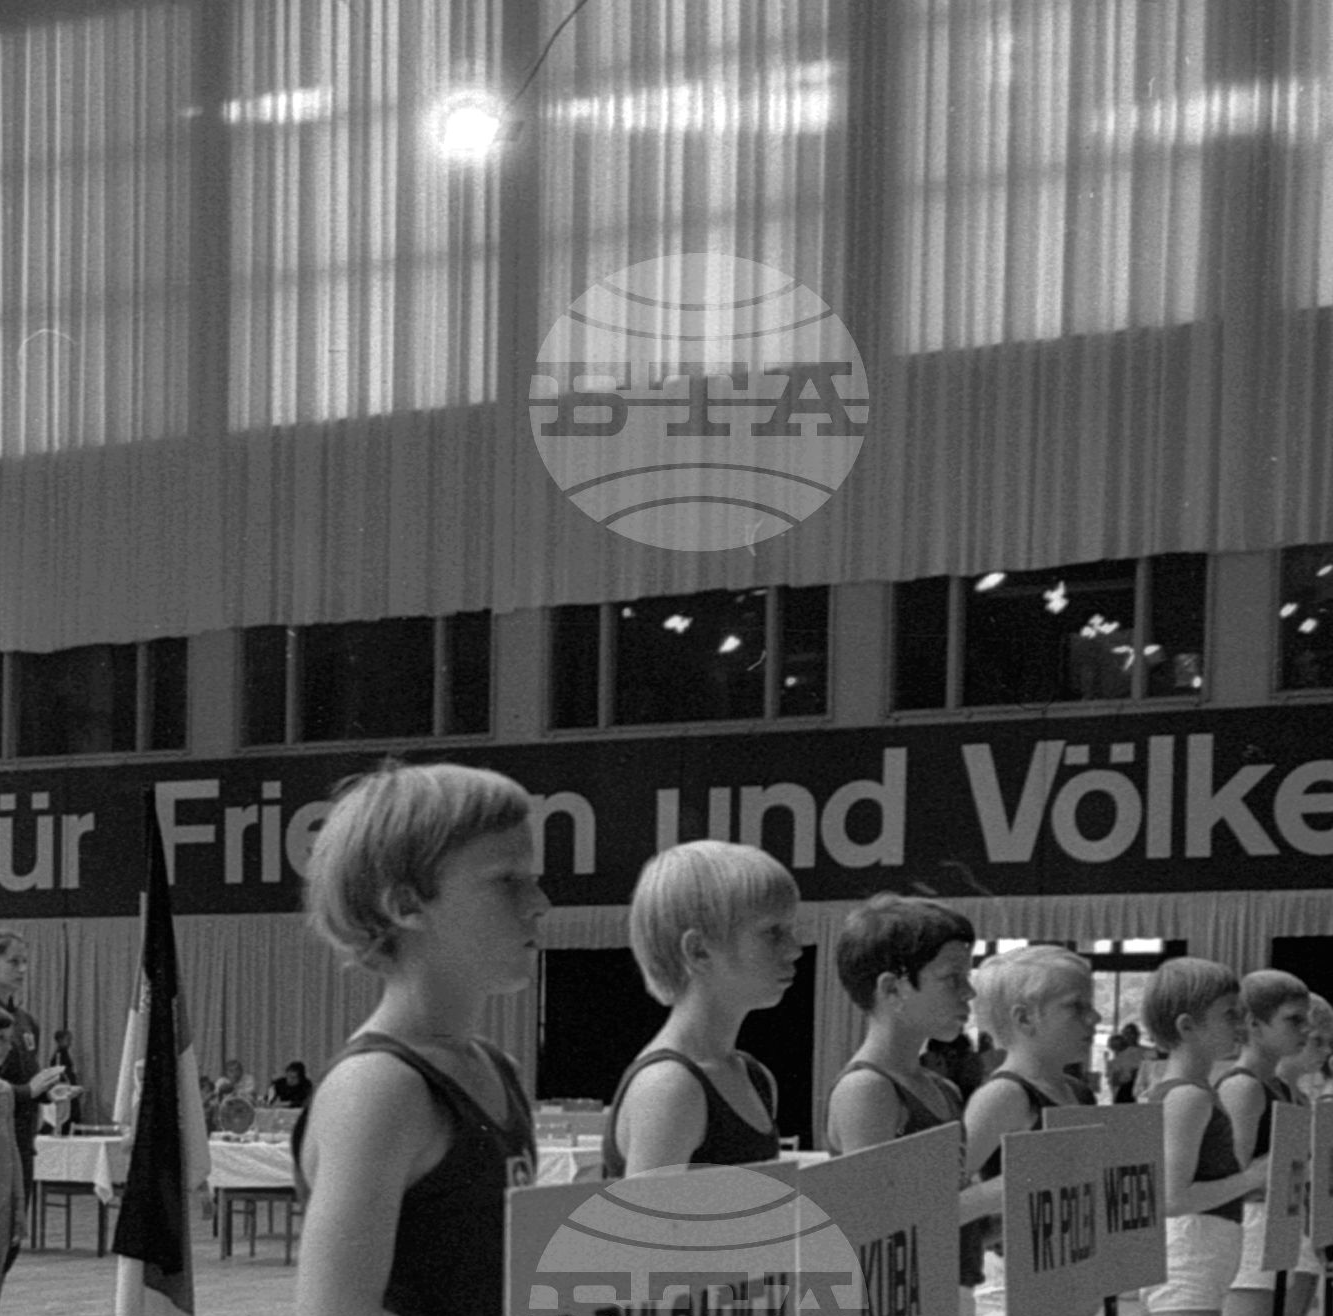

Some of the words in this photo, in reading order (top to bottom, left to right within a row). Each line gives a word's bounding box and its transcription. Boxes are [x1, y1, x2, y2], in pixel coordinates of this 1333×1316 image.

[153, 778, 596, 886] Frien
[656, 746, 908, 869] und
[1029, 1189, 1055, 1274] VR
[1102, 1162, 1157, 1234] WEDEN
